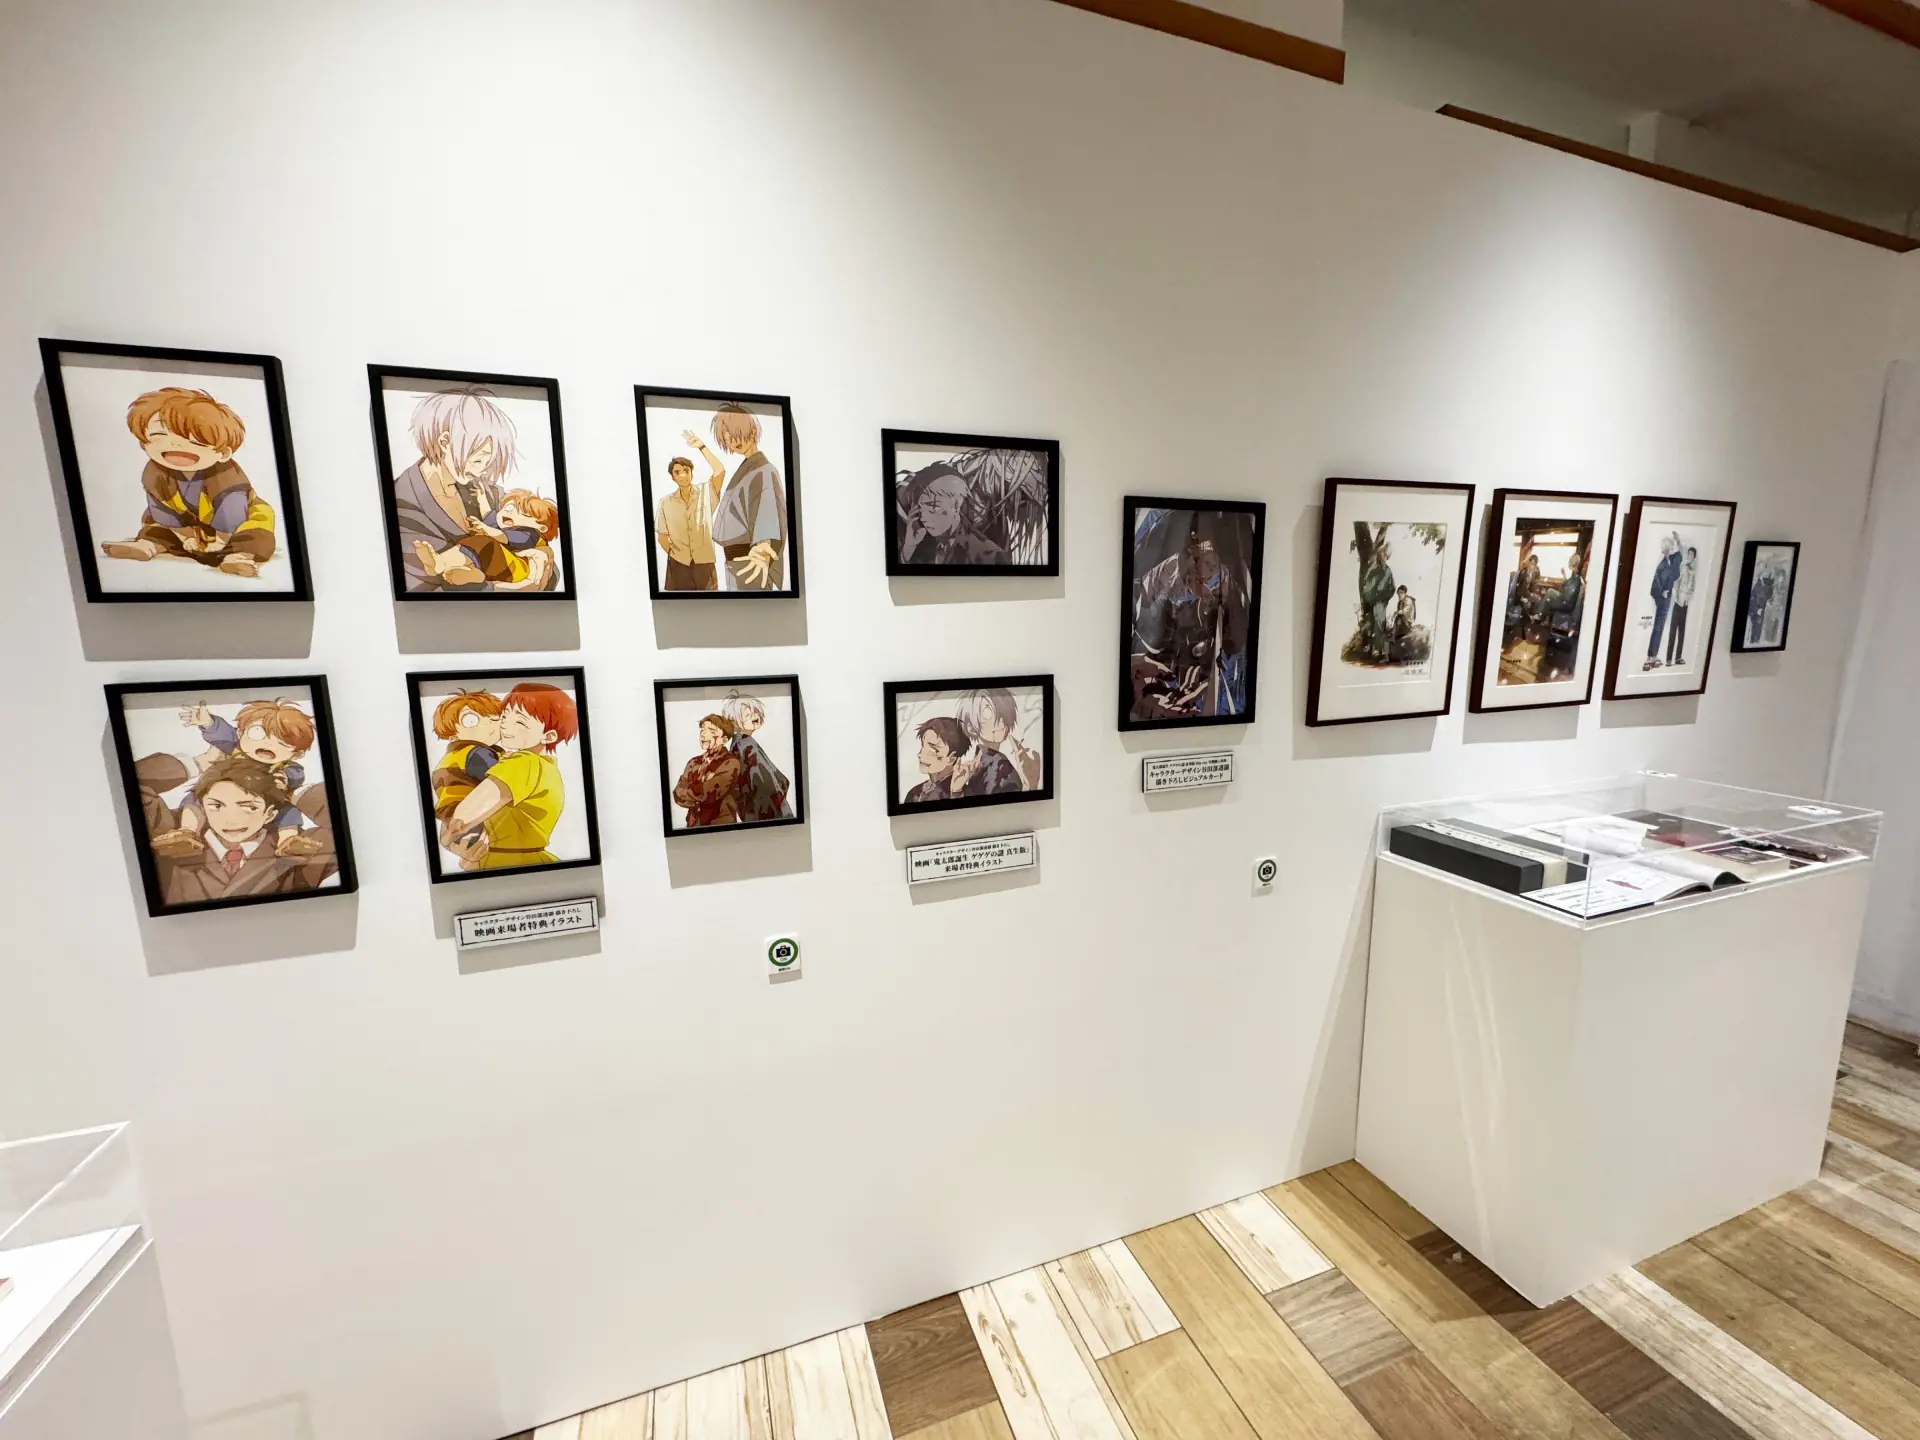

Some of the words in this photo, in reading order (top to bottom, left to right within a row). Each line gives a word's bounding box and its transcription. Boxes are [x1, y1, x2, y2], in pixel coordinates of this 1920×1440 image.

[945, 858, 1003, 872] 来場者特典イラスト
[474, 915, 582, 937] 映画来場者特典イラスト
